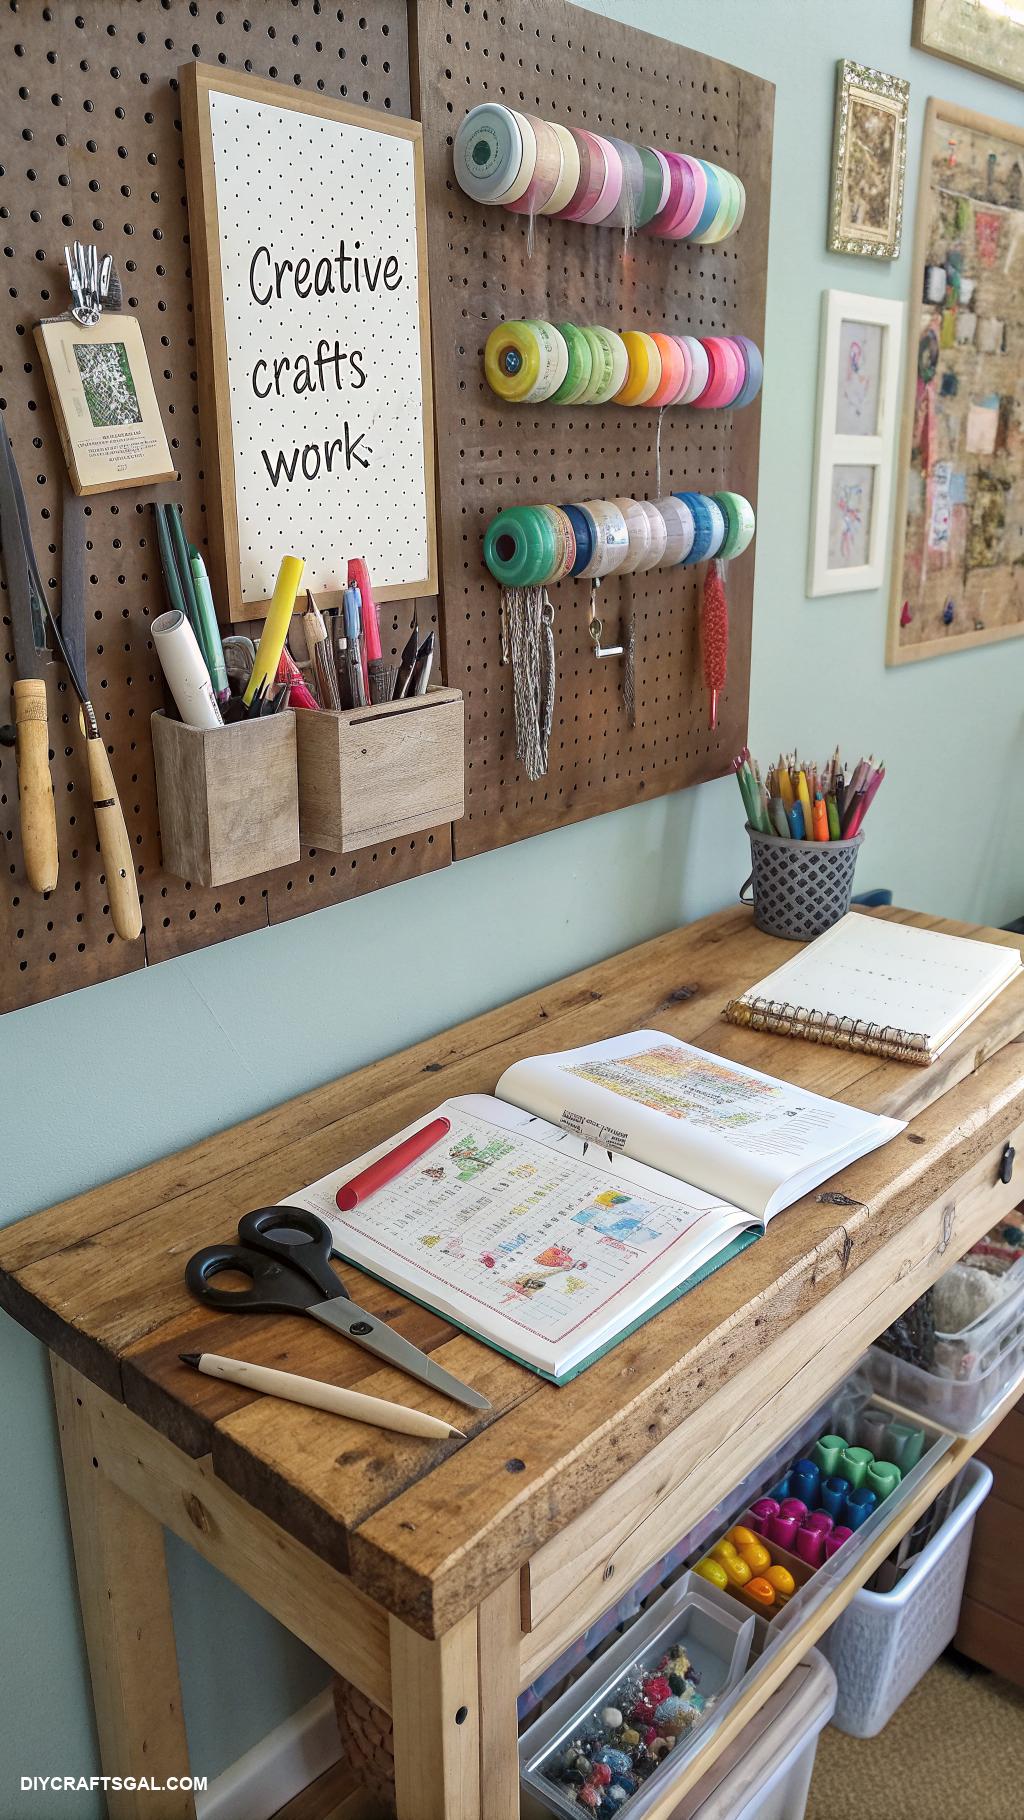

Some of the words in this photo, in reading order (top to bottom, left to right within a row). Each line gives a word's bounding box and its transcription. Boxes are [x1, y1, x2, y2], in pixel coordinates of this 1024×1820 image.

[249, 240, 403, 306] Creative
[252, 339, 367, 399] crafts
[261, 421, 371, 488] work
